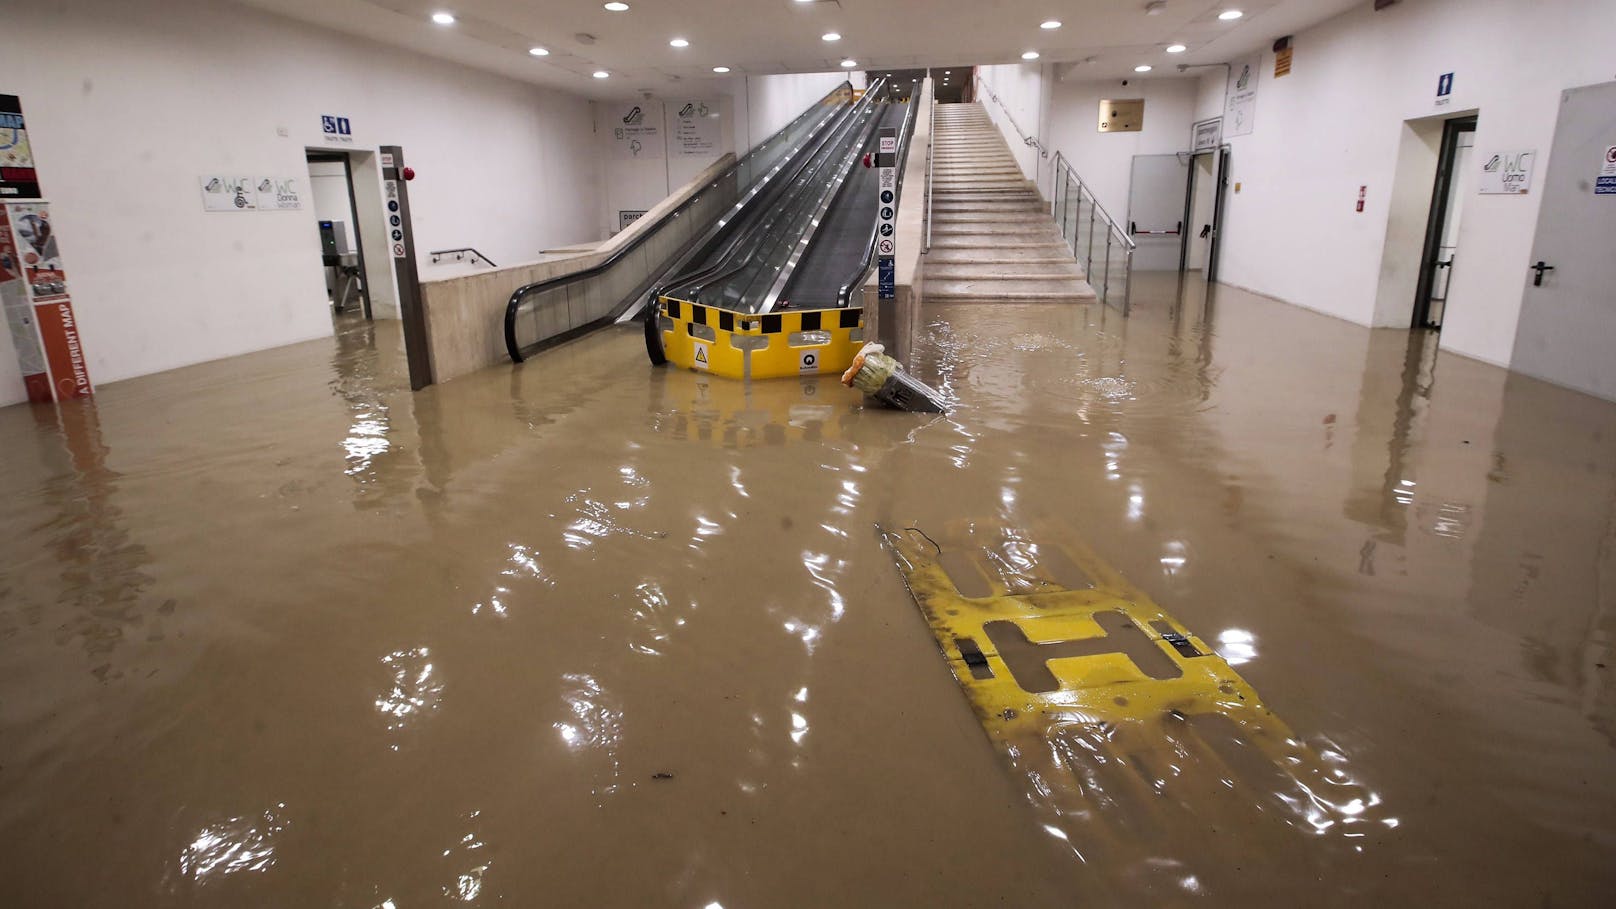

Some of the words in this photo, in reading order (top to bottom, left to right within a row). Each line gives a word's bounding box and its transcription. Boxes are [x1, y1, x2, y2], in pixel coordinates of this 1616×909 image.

[1503, 152, 1531, 172] WC
[1503, 173, 1525, 182] Uomo
[275, 179, 297, 194] WC
[277, 193, 298, 202] Donna
[58, 303, 74, 328] MAP
[64, 329, 88, 386] DIFFERENT
[79, 386, 90, 394] A
